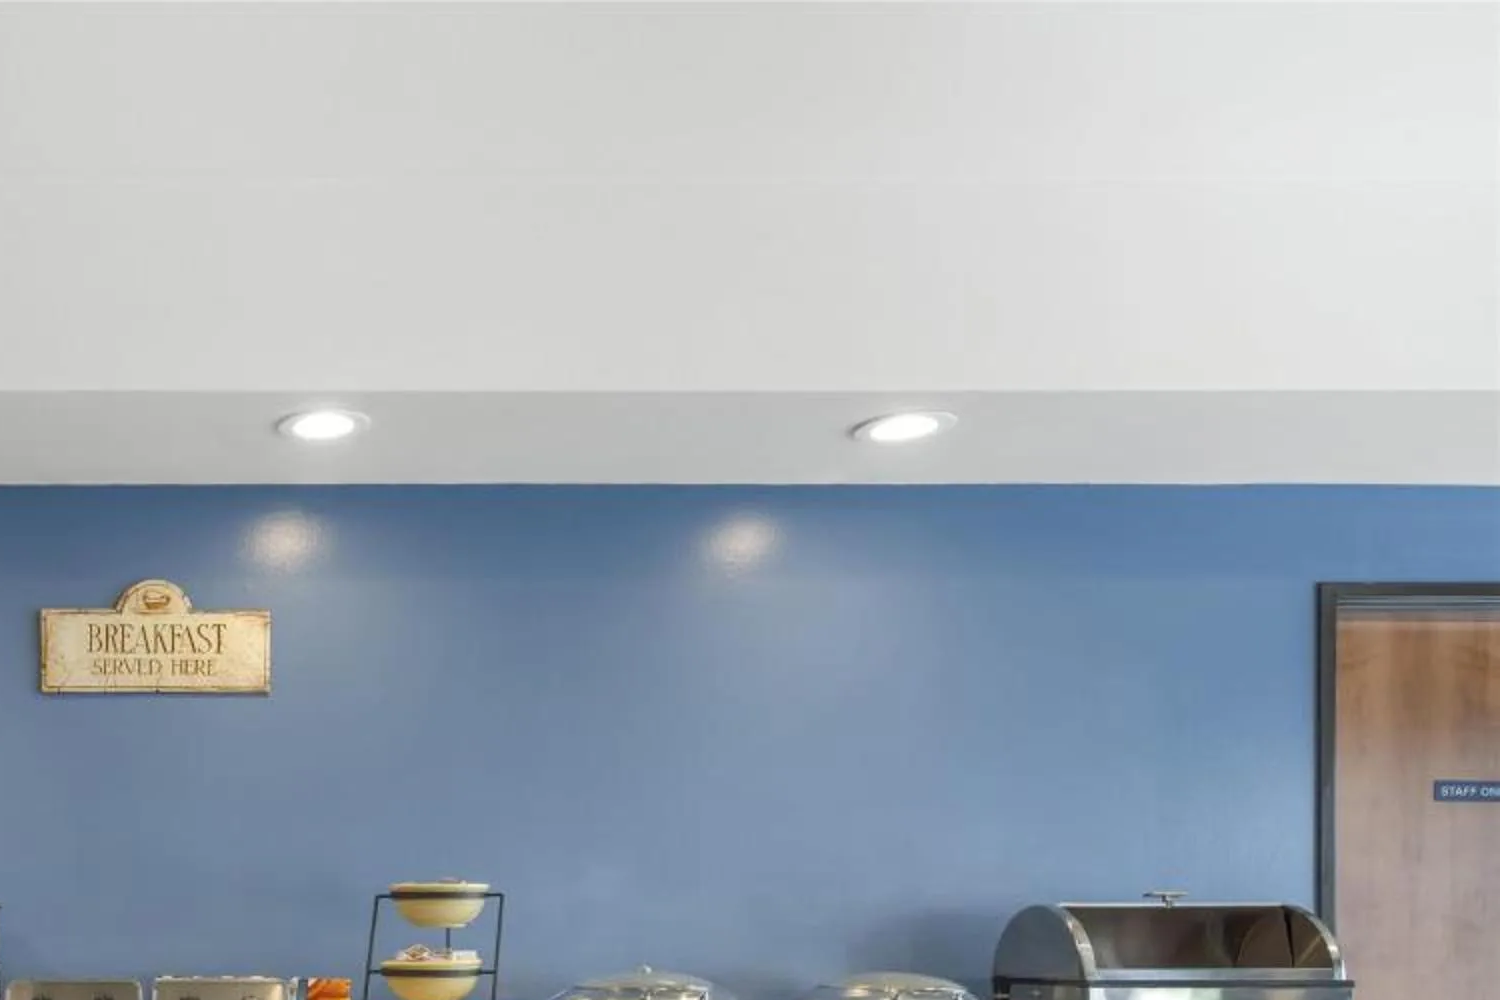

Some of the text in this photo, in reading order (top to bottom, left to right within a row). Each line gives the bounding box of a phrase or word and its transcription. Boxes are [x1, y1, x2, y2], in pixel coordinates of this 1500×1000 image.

[87, 623, 228, 655] BREAKFAST
[91, 657, 215, 676] SERVED HERE
[1441, 785, 1478, 797] STAFF
